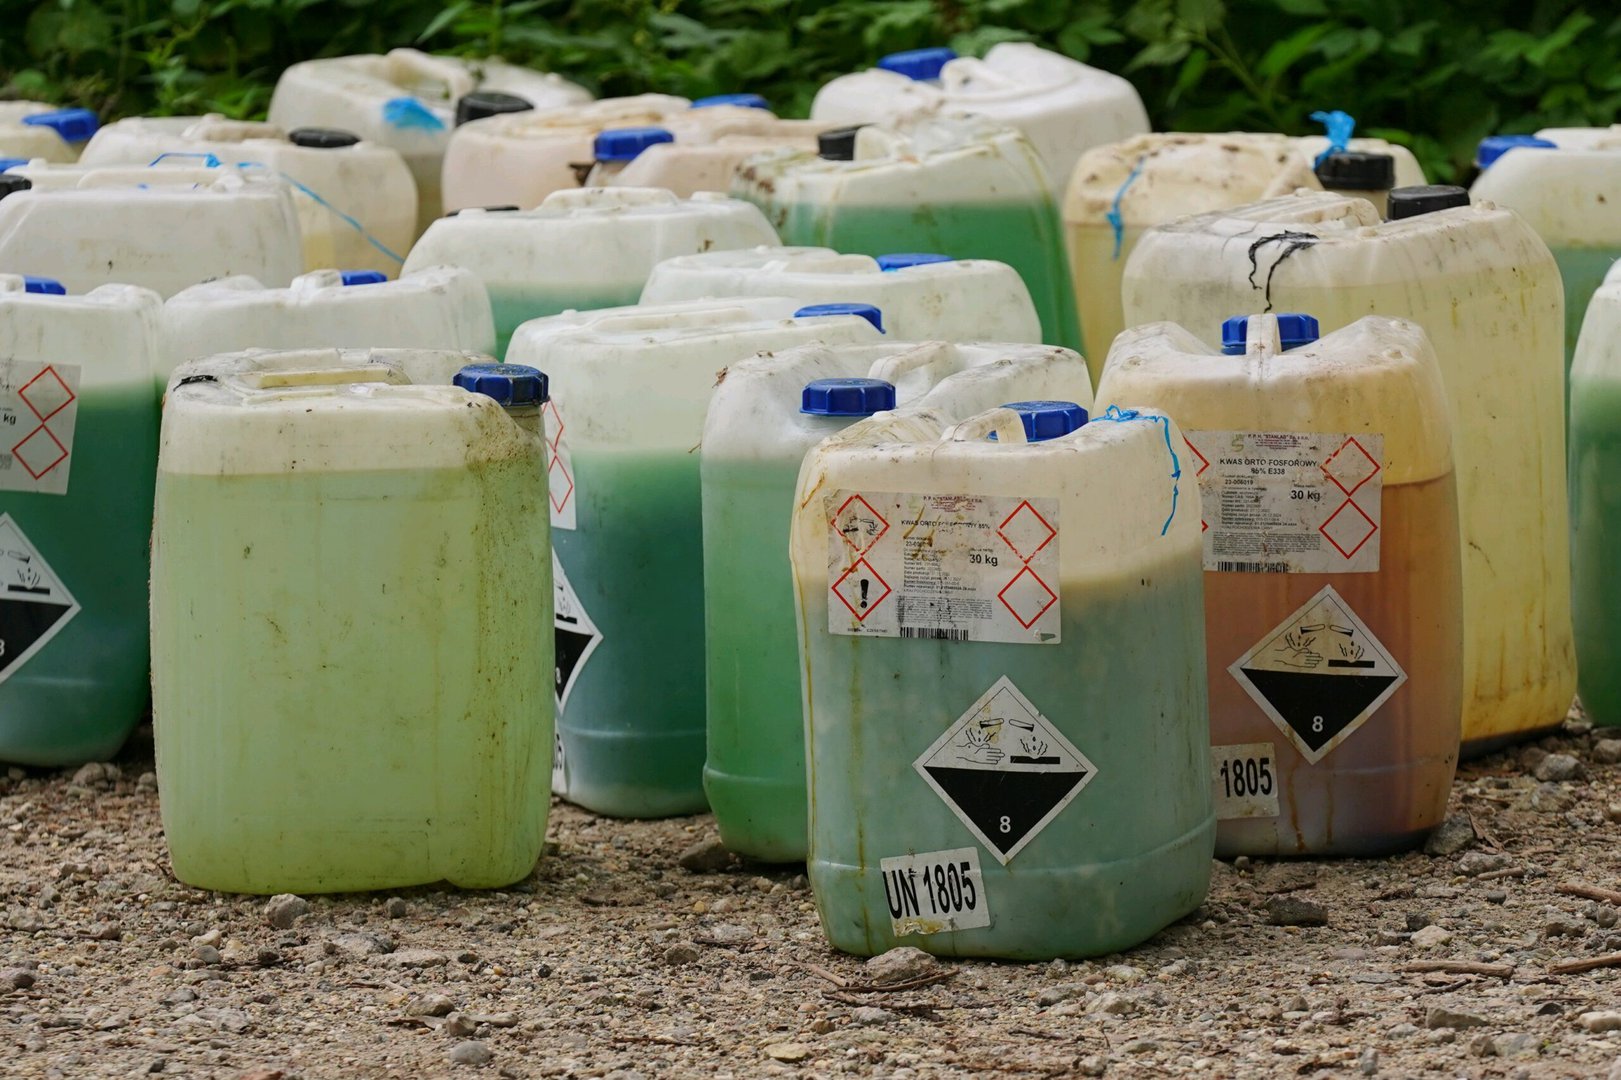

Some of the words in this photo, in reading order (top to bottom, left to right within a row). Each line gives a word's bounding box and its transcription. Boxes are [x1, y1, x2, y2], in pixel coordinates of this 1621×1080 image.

[3, 413, 17, 426] kg
[1244, 458, 1267, 466] ORTO
[1268, 459, 1318, 467] FOSFOROWY
[1290, 490, 1304, 500] 30
[1307, 490, 1321, 502] kg
[969, 553, 983, 564] 30
[985, 554, 998, 567] kg
[1312, 715, 1324, 732] 8
[1220, 757, 1272, 798] 1805
[999, 815, 1011, 833] 8
[882, 867, 920, 919] UN
[923, 861, 977, 914] 1805
